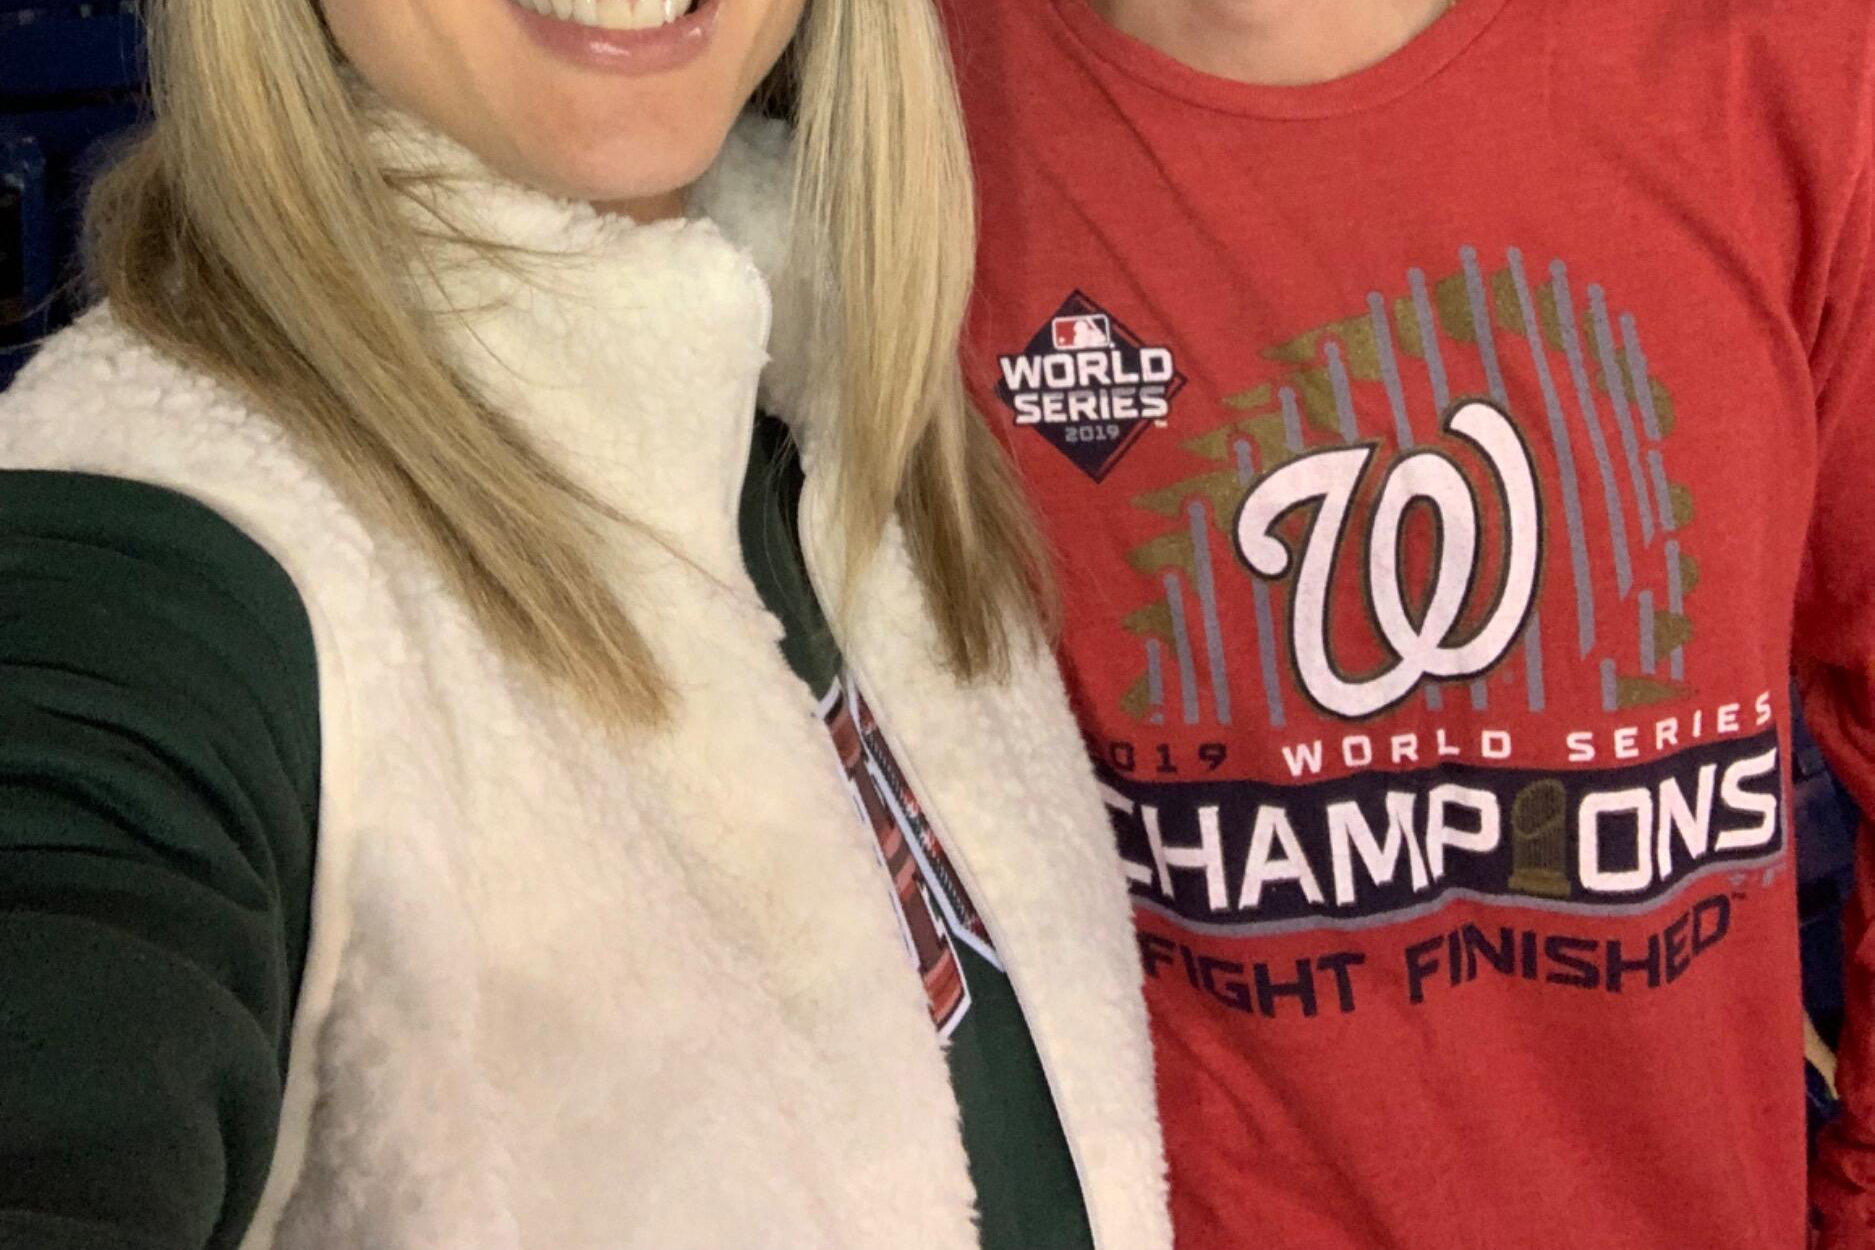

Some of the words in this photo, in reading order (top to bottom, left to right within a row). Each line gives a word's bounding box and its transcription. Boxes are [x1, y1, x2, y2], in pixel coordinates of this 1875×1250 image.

[999, 347, 1174, 391] WORLD
[1013, 385, 1169, 425] SERIES
[1065, 424, 1120, 442] 2019
[1236, 400, 1540, 720] W
[1108, 740, 1228, 774] 019
[1282, 728, 1512, 777] WORLD
[1566, 690, 1773, 762] SERIES
[1135, 931, 1367, 1018] FIGHT
[1404, 893, 1732, 1005] FINISHED
